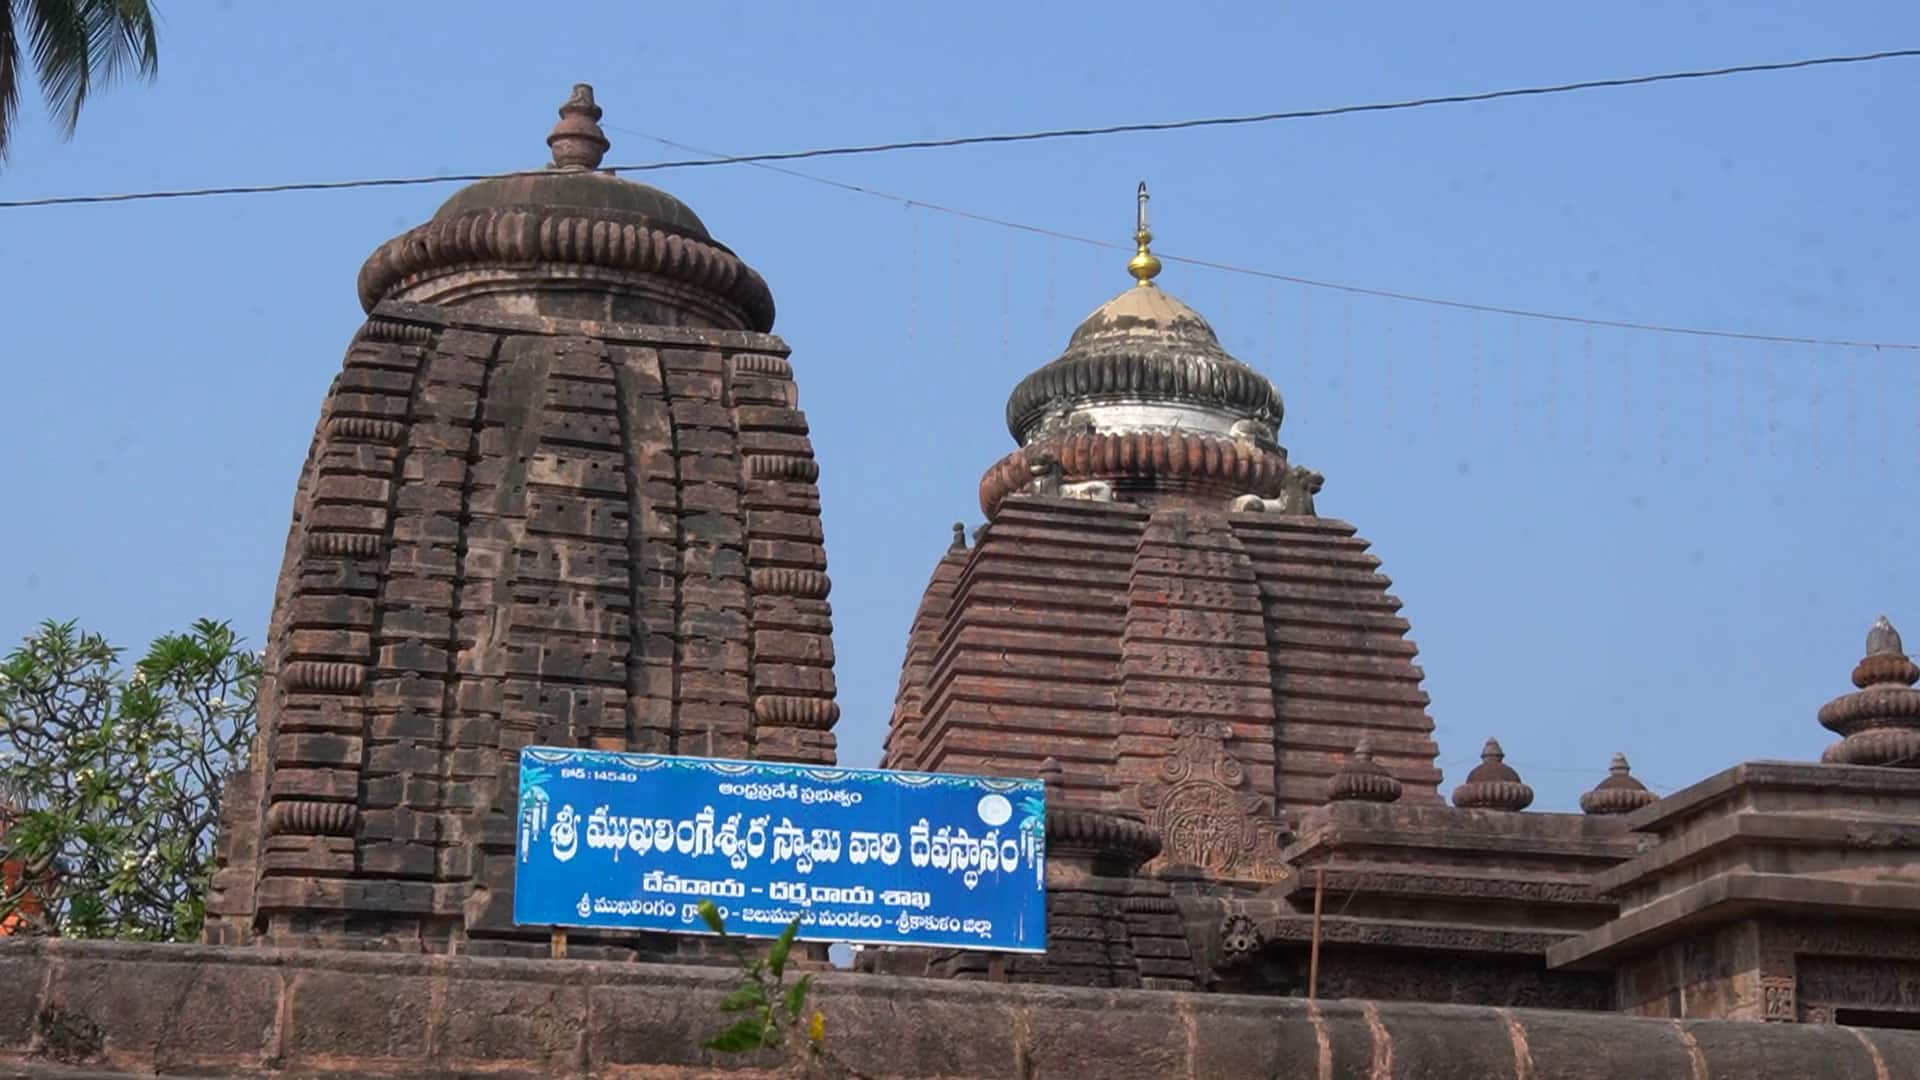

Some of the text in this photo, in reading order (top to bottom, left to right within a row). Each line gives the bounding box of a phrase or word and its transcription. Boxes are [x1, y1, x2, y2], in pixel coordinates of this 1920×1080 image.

[550, 804, 581, 862] శ్రీ
[771, 817, 841, 873] స్వామి
[849, 832, 902, 865] వారి
[909, 818, 1019, 890] దేవస్థానం
[577, 893, 591, 917] శ్రీ
[682, 902, 728, 923] గ్రాం
[643, 870, 745, 897] దేవదాయ
[880, 890, 930, 911] శాఖ
